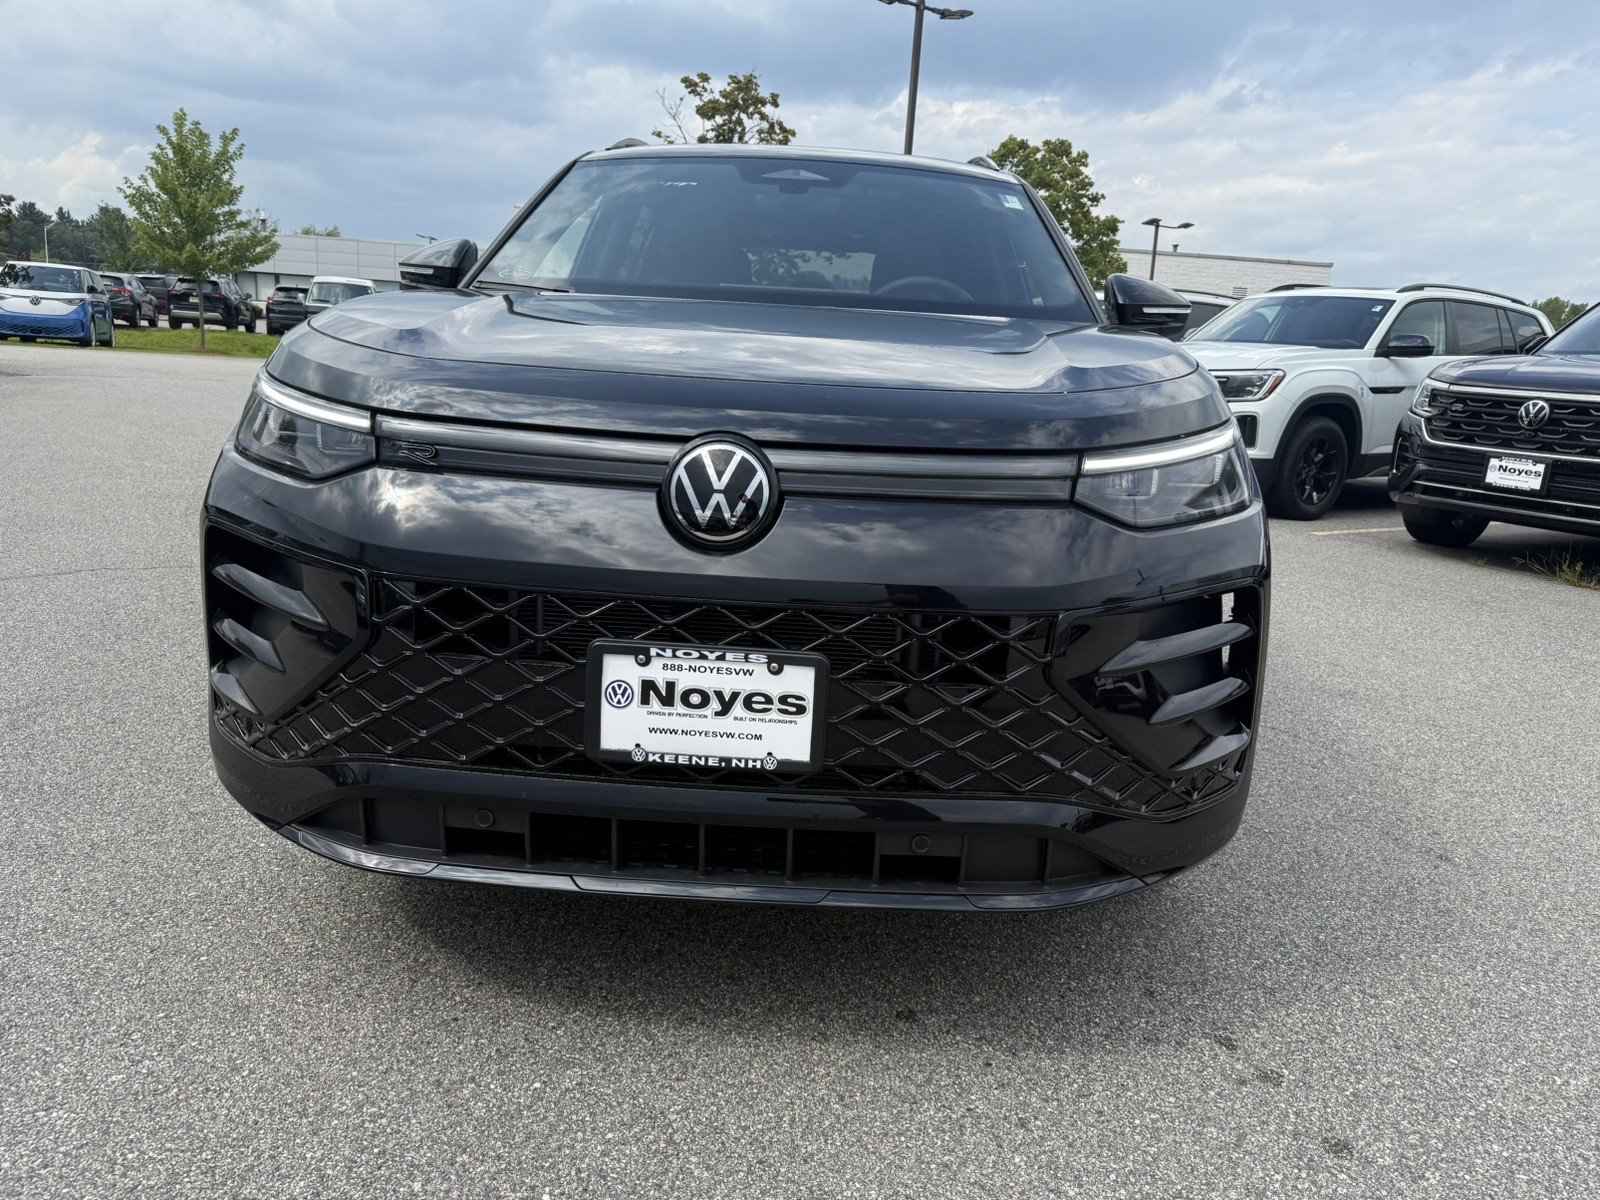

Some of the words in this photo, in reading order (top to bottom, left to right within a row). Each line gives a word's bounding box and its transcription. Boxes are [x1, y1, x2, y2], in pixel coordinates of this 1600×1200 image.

[1498, 465, 1542, 477] Noyes
[650, 648, 768, 663] NOYES
[662, 663, 755, 677] 888-NOYESVW
[639, 678, 808, 717] Noyes
[648, 727, 763, 741] WWW.NOYESVW.COM
[648, 753, 726, 767] KEENE,
[732, 758, 761, 769] NH
